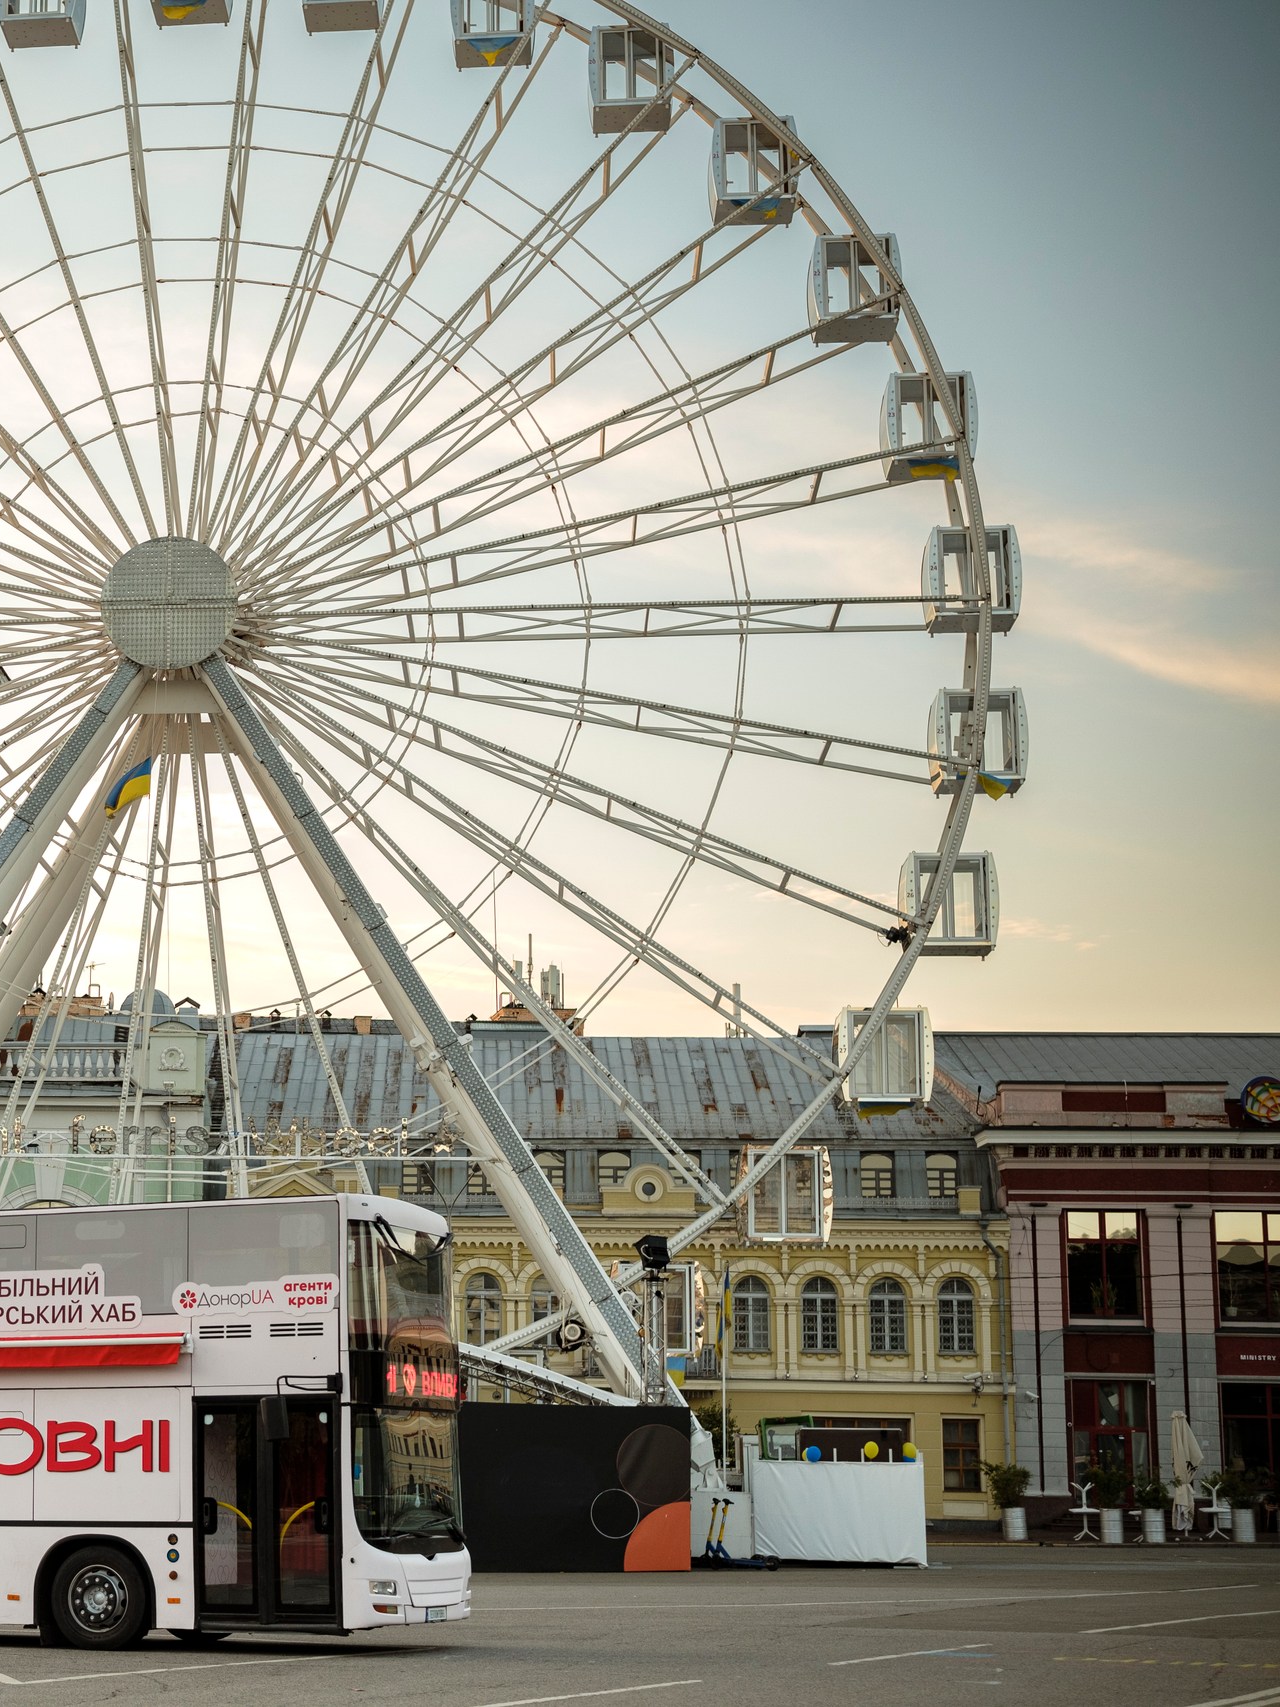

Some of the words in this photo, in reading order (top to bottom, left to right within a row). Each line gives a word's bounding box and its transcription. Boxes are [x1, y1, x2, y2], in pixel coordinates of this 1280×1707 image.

[283, 1282, 333, 1293] агенти
[288, 1294, 328, 1308] крові
[90, 1302, 137, 1324] ХАБ
